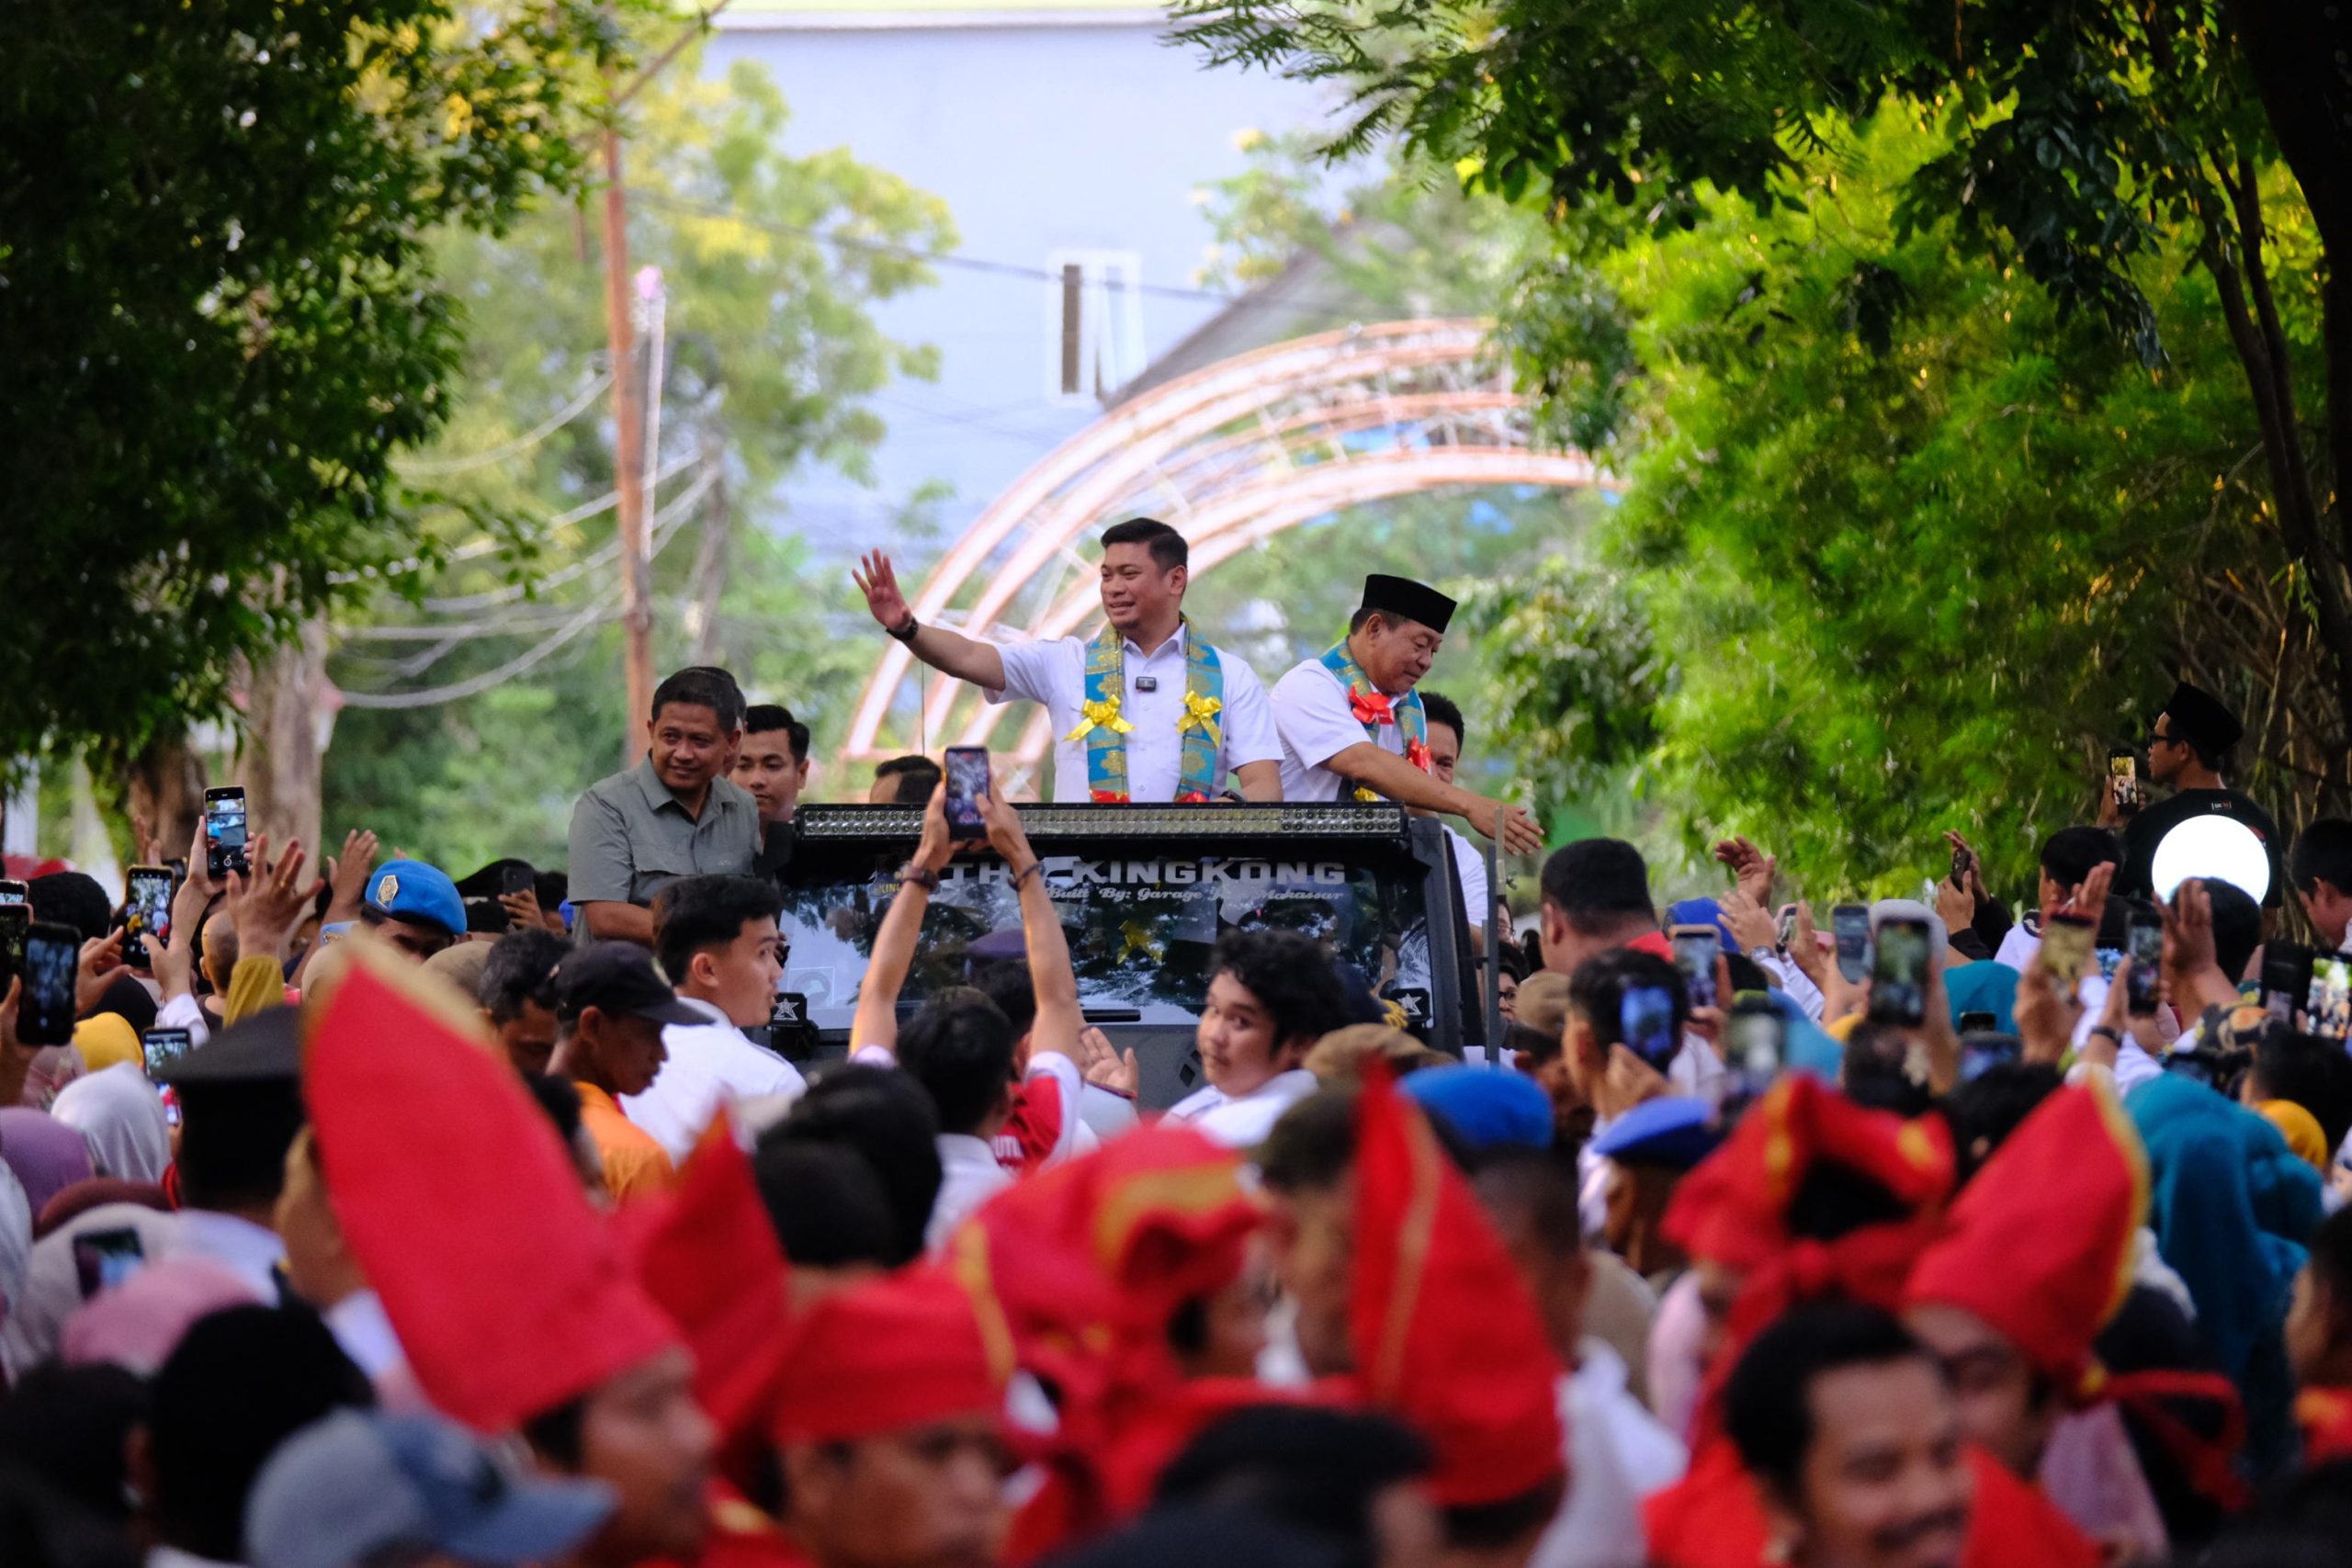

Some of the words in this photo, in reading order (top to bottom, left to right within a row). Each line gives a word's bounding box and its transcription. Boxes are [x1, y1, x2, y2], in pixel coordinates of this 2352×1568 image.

[945, 862, 1014, 885] TH
[1073, 860, 1345, 885] KINGKONG
[1098, 886, 1131, 903] By:
[1136, 886, 1204, 902] Garage
